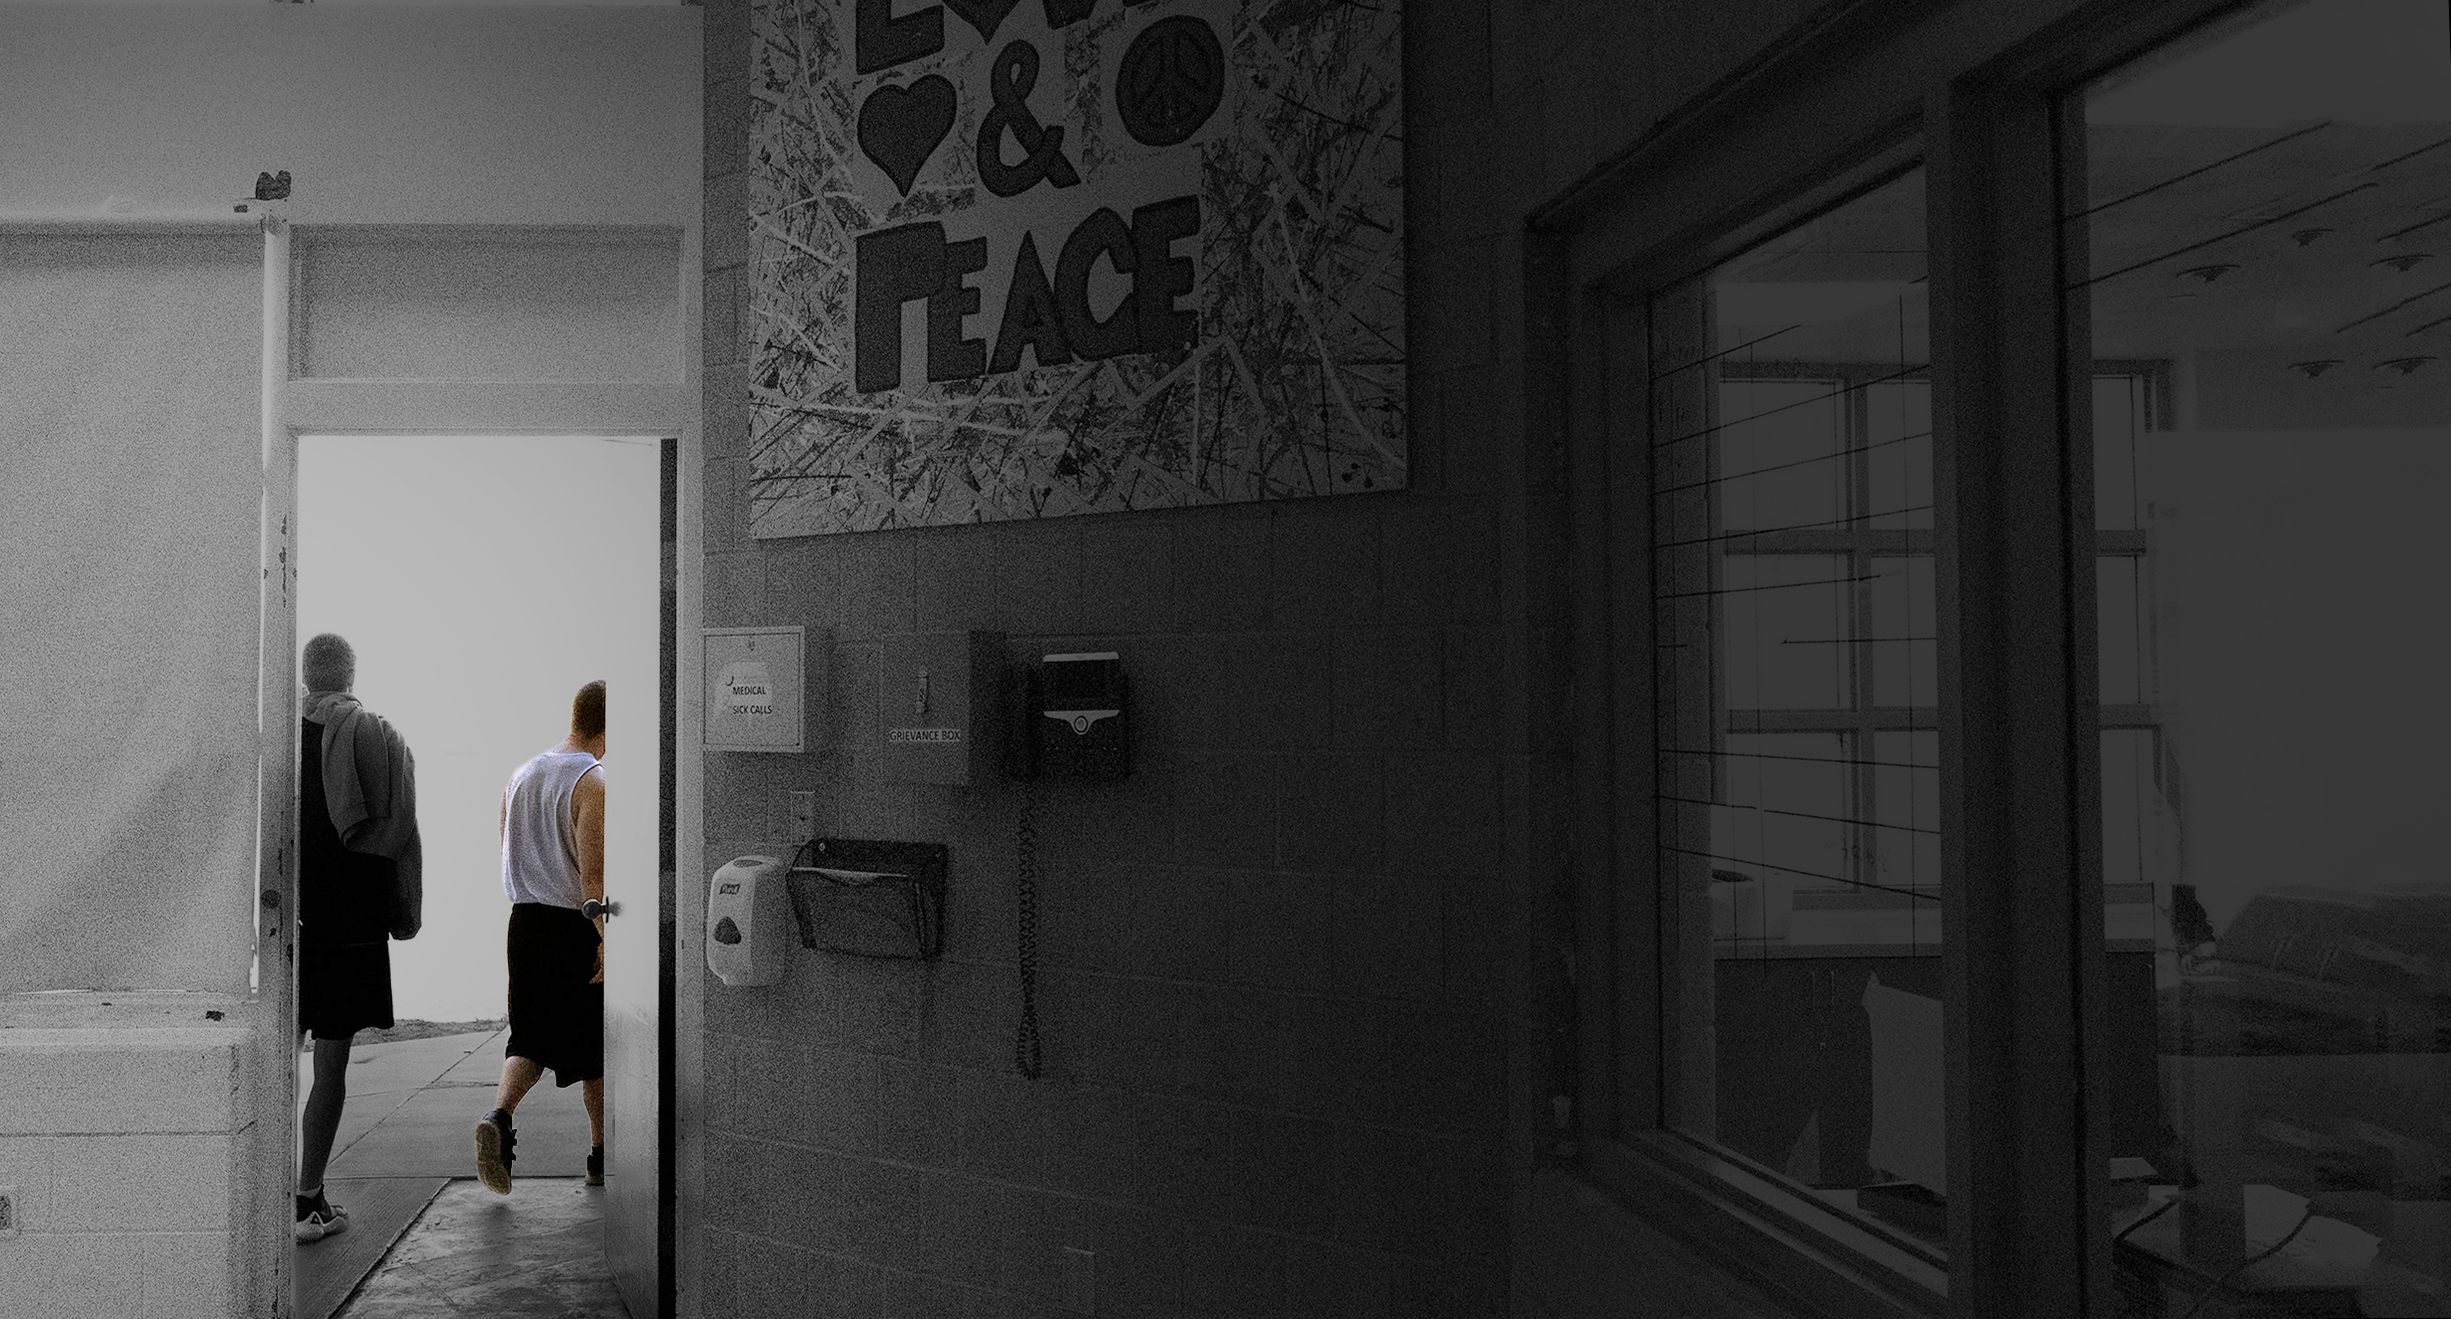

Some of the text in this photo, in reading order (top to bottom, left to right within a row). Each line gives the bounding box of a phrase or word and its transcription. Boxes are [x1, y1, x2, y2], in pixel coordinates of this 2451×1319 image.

[976, 39, 1081, 198] &
[855, 194, 1201, 394] PEACE
[732, 686, 767, 695] MEDICAL
[732, 704, 773, 715] SICK CALLS
[890, 730, 961, 741] GRIEVANCE BOX
